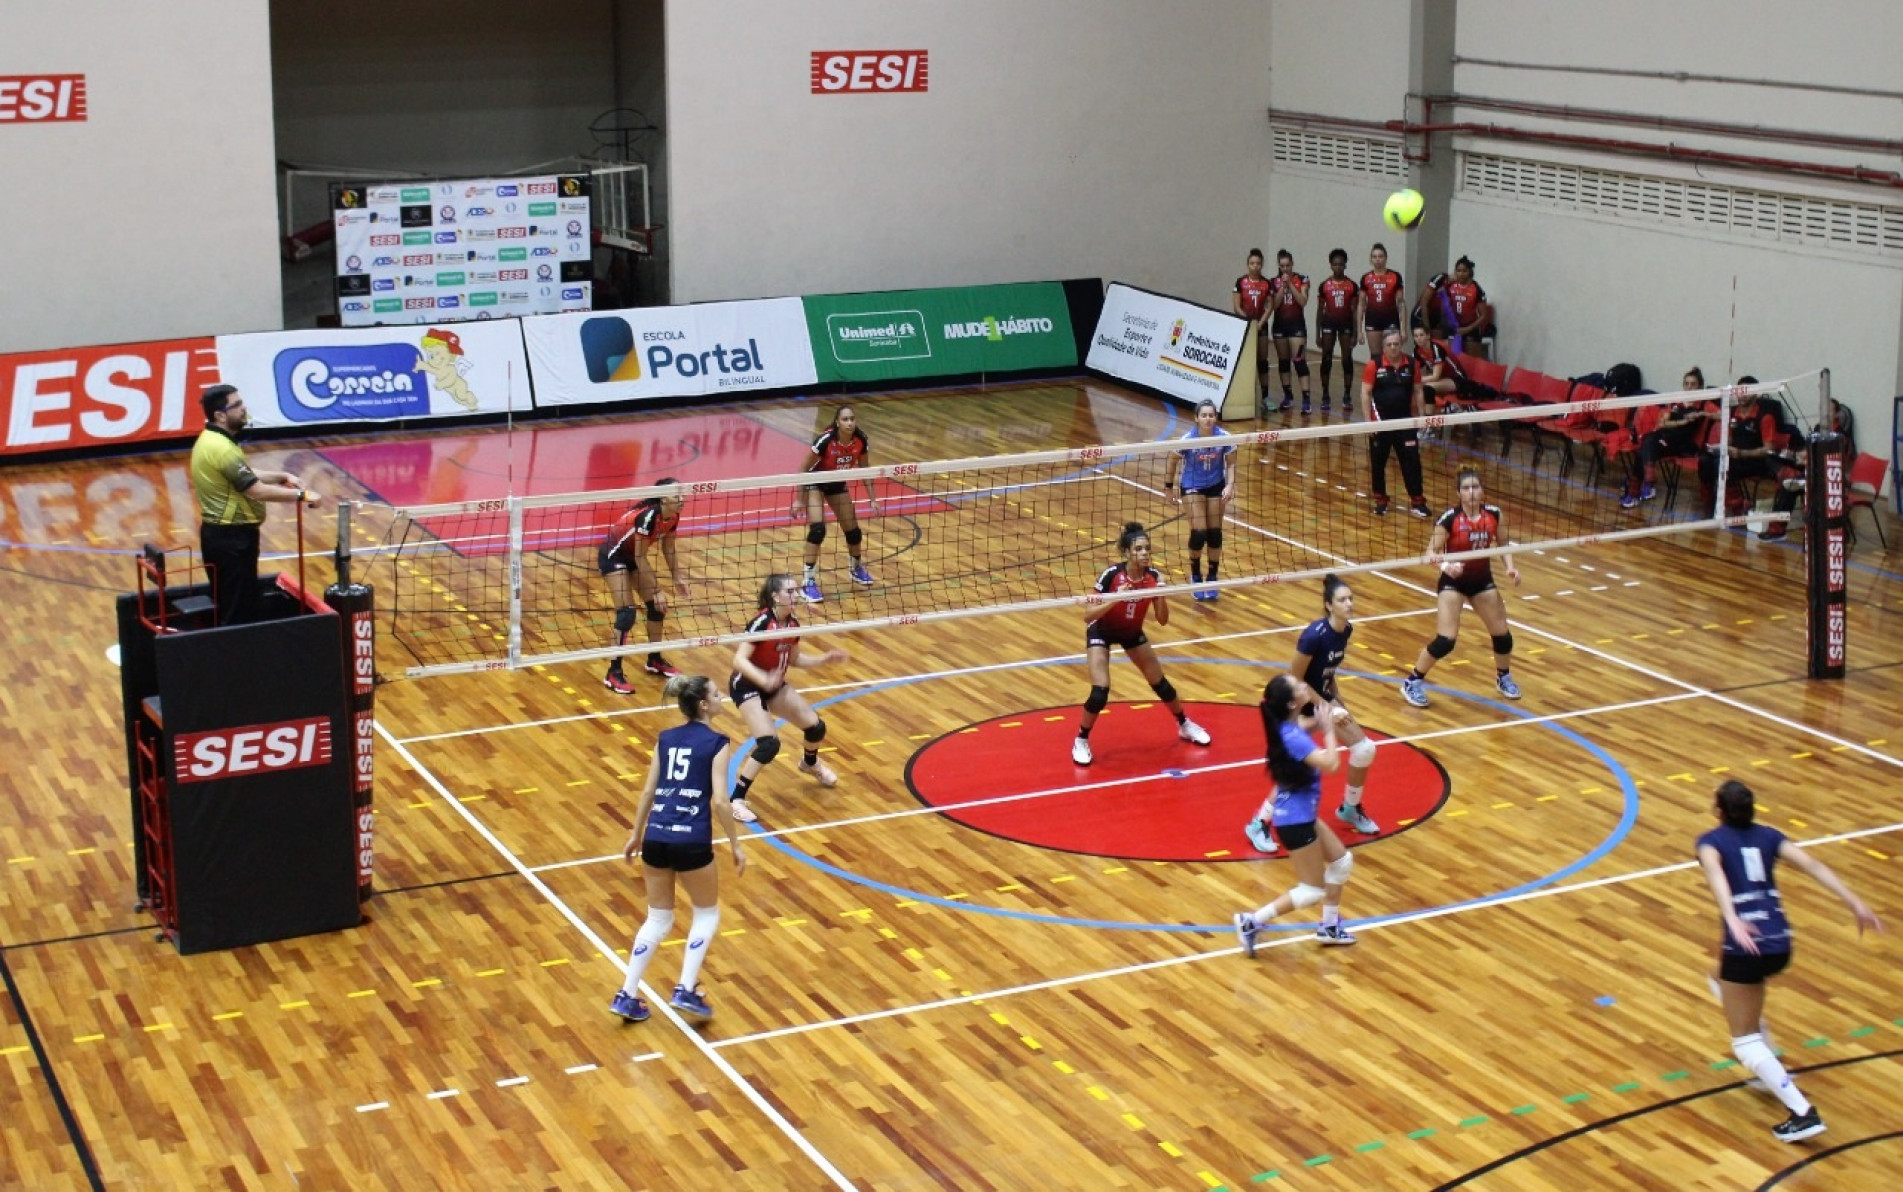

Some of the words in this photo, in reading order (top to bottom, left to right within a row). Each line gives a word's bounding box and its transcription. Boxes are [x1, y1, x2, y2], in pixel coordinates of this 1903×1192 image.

[821, 55, 918, 90] SESI
[0, 79, 72, 119] ESI
[1375, 289, 1382, 302] 3
[643, 331, 686, 341] ESCOLA
[840, 323, 896, 339] Unimed
[1187, 332, 1220, 352] Prefeitura
[1222, 343, 1231, 354] de
[648, 338, 764, 379] Portal
[1183, 346, 1228, 370] SOROCABA
[291, 358, 413, 408] Correia
[718, 375, 767, 388] BILINGUAL
[6, 349, 189, 446] ESI
[1426, 417, 1445, 428] SESI
[1258, 432, 1279, 443] SESI
[1081, 449, 1102, 459] SESI
[893, 465, 917, 476] SESI
[692, 483, 718, 494] SESI
[1827, 460, 1844, 512] SESI
[478, 500, 505, 512] SESI
[1829, 535, 1845, 586] SESI
[899, 616, 918, 625] SESI
[1125, 602, 1137, 619] 9
[1829, 609, 1845, 661] SESI
[355, 619, 373, 685] SESI
[190, 724, 317, 777] SESI
[356, 718, 373, 783] SESI
[666, 747, 692, 781] 15
[359, 813, 373, 877] SESI
